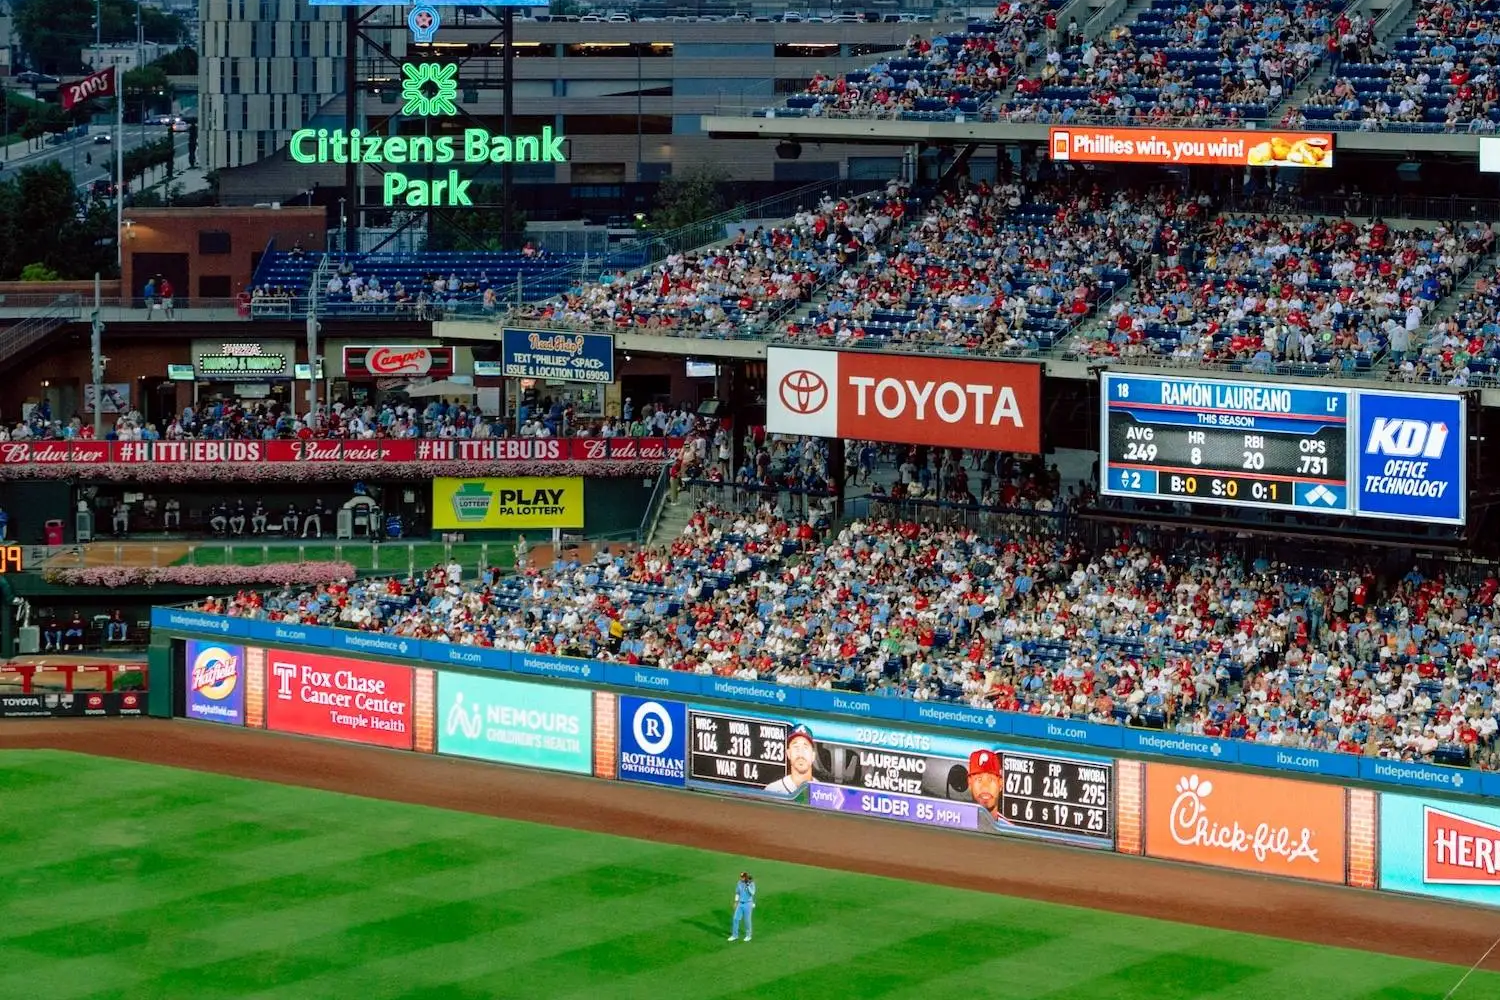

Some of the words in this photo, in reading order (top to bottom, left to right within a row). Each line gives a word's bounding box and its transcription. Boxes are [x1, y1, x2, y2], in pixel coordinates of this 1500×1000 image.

[290, 127, 454, 164] Citizens
[463, 125, 565, 163] Bank
[1073, 134, 1134, 154] Phillies
[1136, 138, 1171, 159] win,
[1173, 142, 1204, 161] you
[1206, 138, 1244, 158] win!
[383, 171, 472, 207] Park
[528, 333, 555, 351] Need
[555, 335, 584, 357] Help?
[371, 347, 426, 374] Campo's
[514, 352, 532, 364] TEXT
[506, 364, 526, 374] ISSUE
[529, 366, 534, 375] &
[536, 366, 573, 378] LOCATION
[575, 368, 586, 379] TO
[586, 369, 610, 381] 69050
[849, 376, 1024, 428] TOYOTA
[1116, 382, 1129, 398] 18
[1161, 382, 1214, 409] RAMÓN
[1216, 386, 1291, 413] LAUREANO
[1326, 396, 1338, 412] LF
[1198, 413, 1216, 424] THIS
[1218, 414, 1254, 428] SEASON
[1126, 427, 1154, 442] AVG
[1188, 431, 1205, 445] HR
[1244, 435, 1264, 450] RBI
[1300, 439, 1326, 454] OPS
[1365, 417, 1448, 460] KDI
[2, 443, 102, 462] Budweiser
[120, 442, 260, 460] #HITTHEBUDS
[291, 442, 390, 462] Budweiser
[418, 440, 560, 460] #HITTHEBUDS
[1123, 444, 1158, 462] .249
[1191, 448, 1201, 466] 8
[1243, 452, 1264, 470] 20
[1296, 456, 1328, 476] .731
[1384, 460, 1428, 478] OFFICE
[500, 488, 564, 505] PLAY
[1171, 476, 1196, 494] B:0
[1212, 478, 1238, 497] S:0
[1365, 476, 1448, 498] TECHNOLOGY
[460, 500, 489, 508] LOTTERY
[500, 506, 514, 516] PA
[516, 506, 565, 516] LOTTERY
[170, 614, 220, 630] Independence
[276, 628, 306, 640] ibx.com
[346, 636, 398, 650] Independence
[449, 648, 482, 663] ibx.com
[192, 656, 238, 691] Hatfield
[524, 658, 580, 675] Independence
[301, 665, 332, 688] Fox
[334, 670, 386, 695] Chase
[634, 672, 668, 686] ibx.com
[301, 686, 352, 708] Cancer
[354, 690, 406, 716] Center
[715, 682, 774, 700] Independence
[4, 698, 40, 706] TOYOTA
[834, 696, 870, 712] ibx.com
[330, 710, 370, 729] Temple
[370, 714, 406, 734] Health
[486, 704, 580, 736] NEMOURS
[920, 707, 984, 726] Independence
[646, 718, 661, 738] R
[696, 714, 718, 732] WRC+
[729, 720, 750, 737] WOBA
[760, 724, 784, 741] XWOBA
[1048, 723, 1086, 739] ibx.com
[544, 736, 580, 752] HEALTH
[697, 732, 717, 752] 104
[727, 736, 752, 758] .318
[760, 741, 784, 762] .323
[857, 728, 886, 744] 2024
[889, 732, 930, 750] STATS
[1139, 734, 1208, 755] Independence
[622, 752, 684, 771] ROTHMAN
[716, 758, 736, 776] WAR
[743, 762, 758, 780] 0.4
[860, 751, 926, 774] LAUREANO
[1276, 751, 1319, 768] ibx.com
[622, 763, 684, 778] ORTHOPAEDICS
[1049, 764, 1061, 776] FIP
[1078, 768, 1106, 784] XWOBA
[1375, 762, 1450, 785] Independence
[864, 772, 922, 794] SÁNCHEZ
[1006, 773, 1032, 796] 67.0
[1043, 778, 1068, 800] 2.84
[1078, 784, 1105, 806] .295
[812, 788, 838, 804] xfinity
[862, 794, 910, 818] SLIDER
[916, 803, 934, 820] 85
[936, 810, 960, 823] MPH
[1012, 804, 1018, 816] B
[1025, 800, 1034, 820] 6
[1042, 809, 1048, 821] S
[1054, 805, 1068, 826] 19
[1074, 812, 1084, 826] TP
[1088, 810, 1103, 830] 25
[1170, 783, 1320, 862] Chick-fil-A
